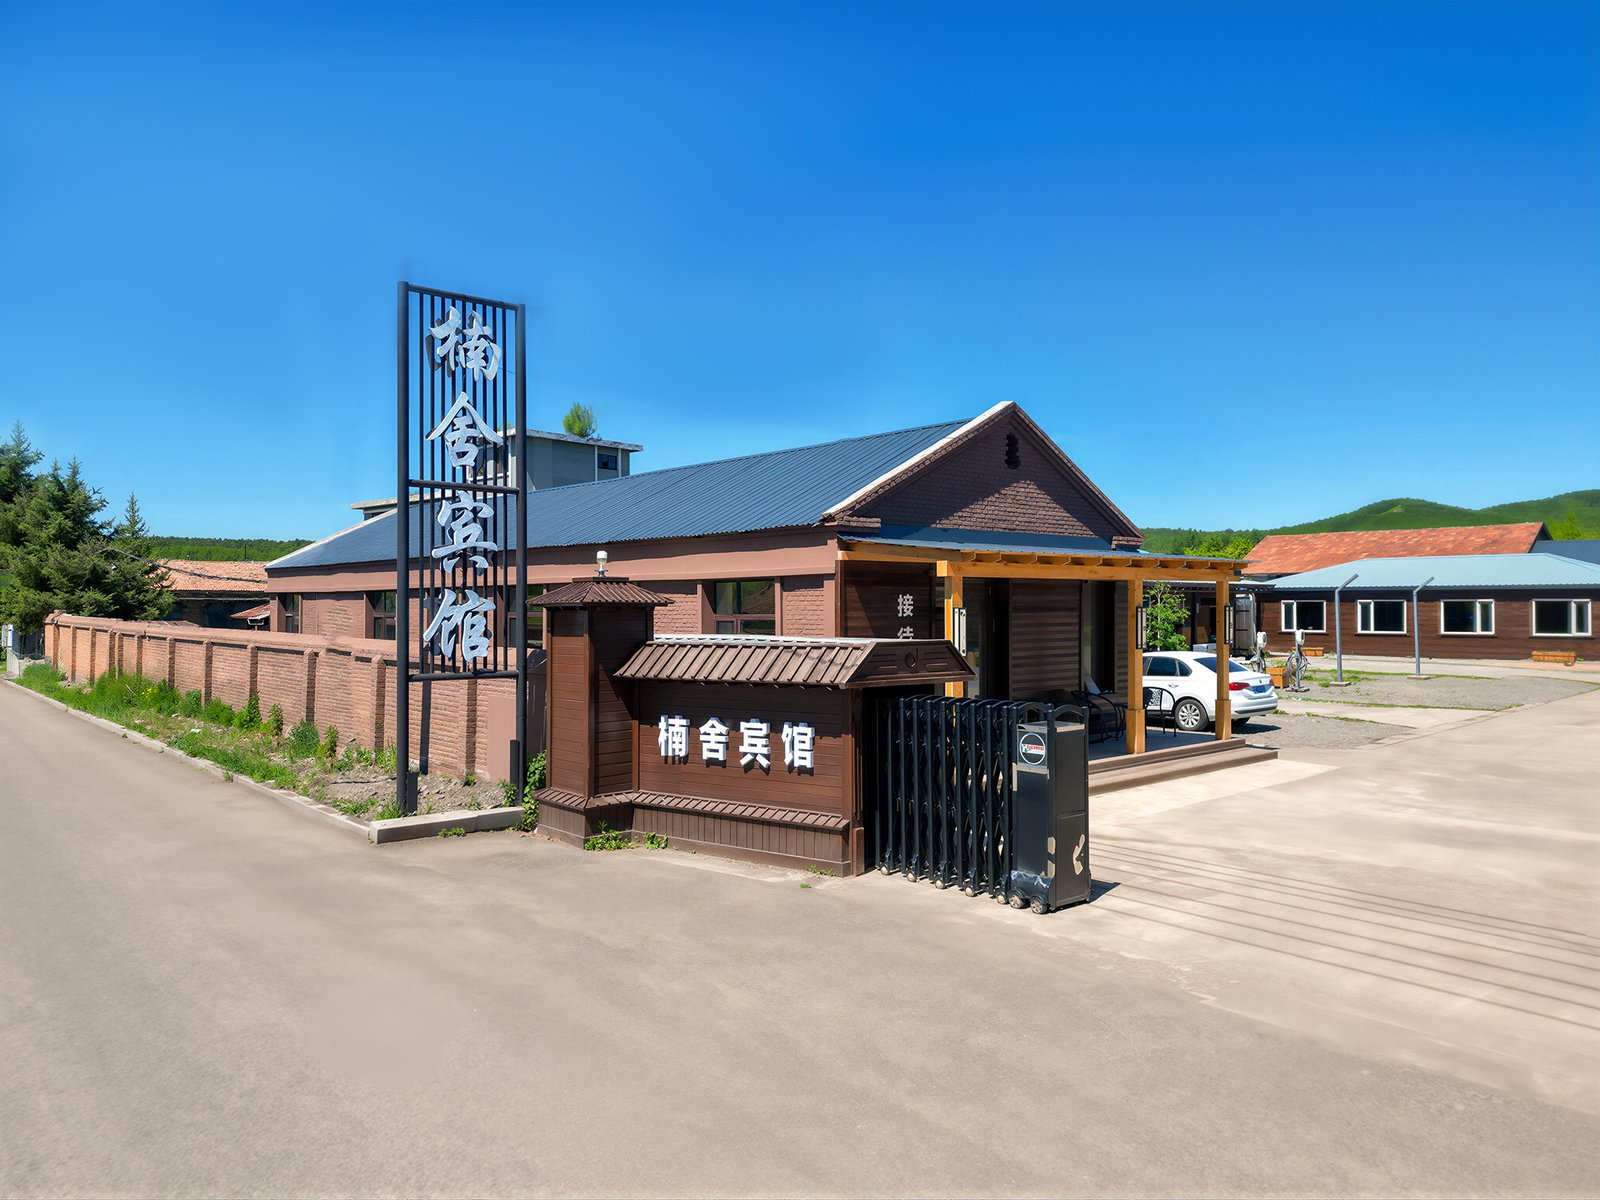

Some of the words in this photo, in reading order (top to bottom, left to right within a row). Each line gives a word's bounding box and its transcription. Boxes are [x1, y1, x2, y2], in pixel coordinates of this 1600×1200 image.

[424, 305, 502, 663] 楠舍宾馆
[658, 714, 816, 770] 楠舍宾馆
